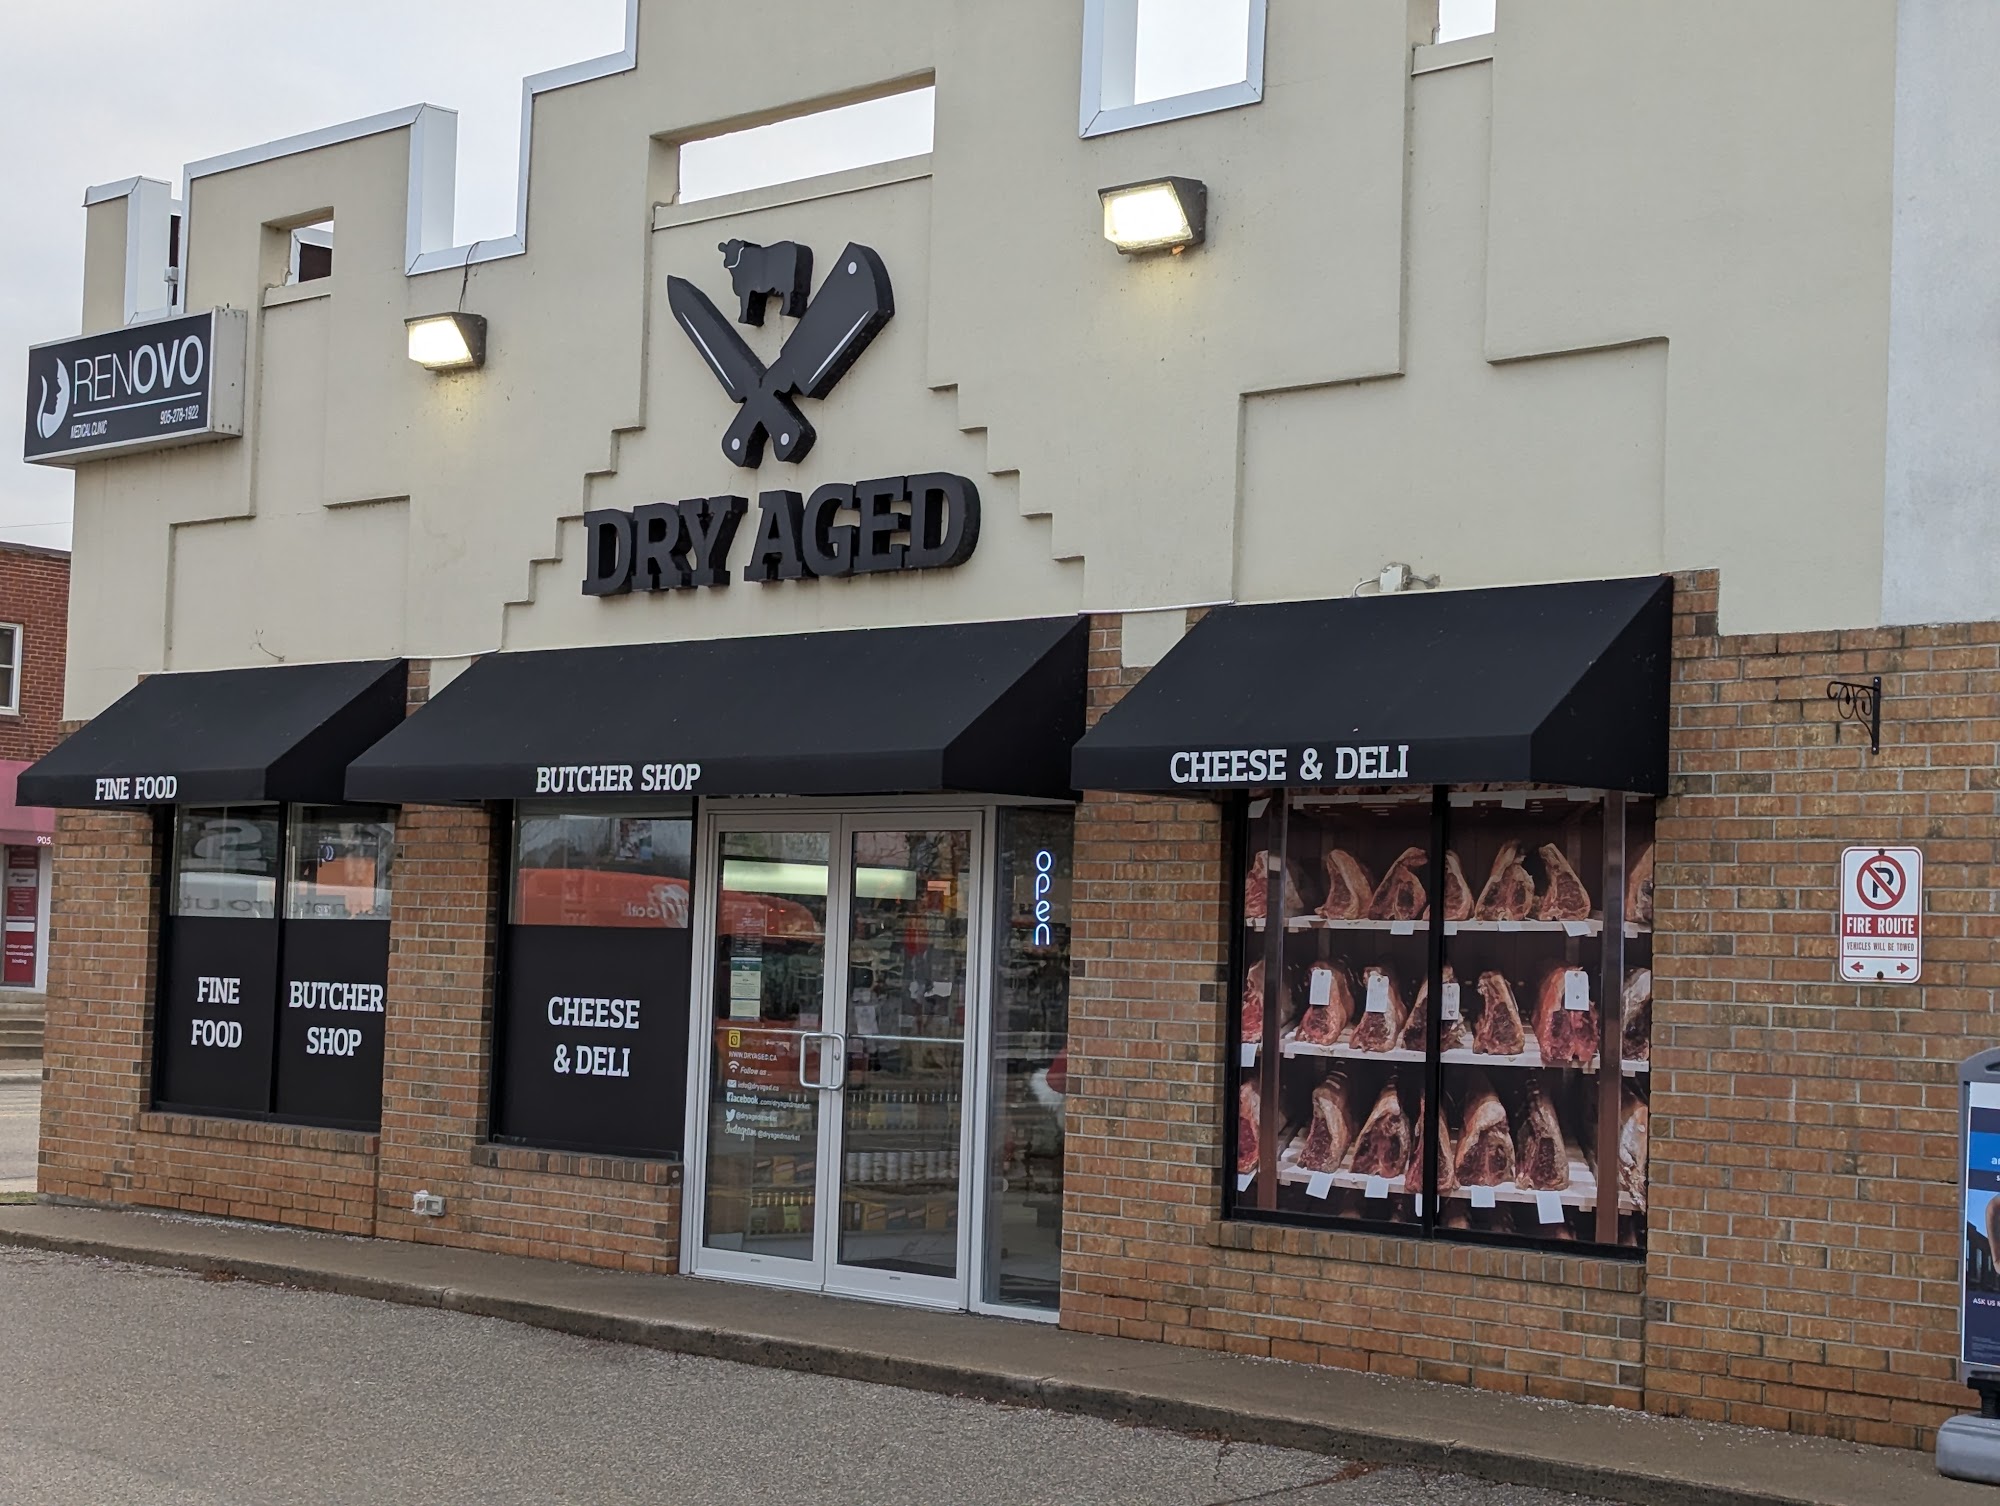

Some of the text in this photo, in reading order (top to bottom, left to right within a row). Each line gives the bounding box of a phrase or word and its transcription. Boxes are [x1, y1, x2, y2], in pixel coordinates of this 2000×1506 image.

[74, 335, 204, 405] RENOVO
[70, 420, 107, 439] MEDICAL CLINIC
[582, 471, 981, 596] DRY AGED
[535, 763, 701, 793] BUTCHER SHOP
[1170, 745, 1409, 784] CHEESE & DELI
[94, 775, 178, 801] FINE FOOD
[1035, 850, 1052, 946] open
[1846, 916, 1915, 935] FIRE ROUTE
[1846, 942, 1915, 952] VEHICLES WILL BE TOWED
[197, 977, 240, 1004] FINE
[288, 981, 384, 1012] BUTCHER
[547, 997, 640, 1029] CHEESE
[191, 1020, 242, 1048] FOOD
[306, 1027, 362, 1057] SHOP
[553, 1044, 630, 1077] & DELI
[1972, 1297, 1986, 1306] ASK
[1986, 1299, 1996, 1307] US
